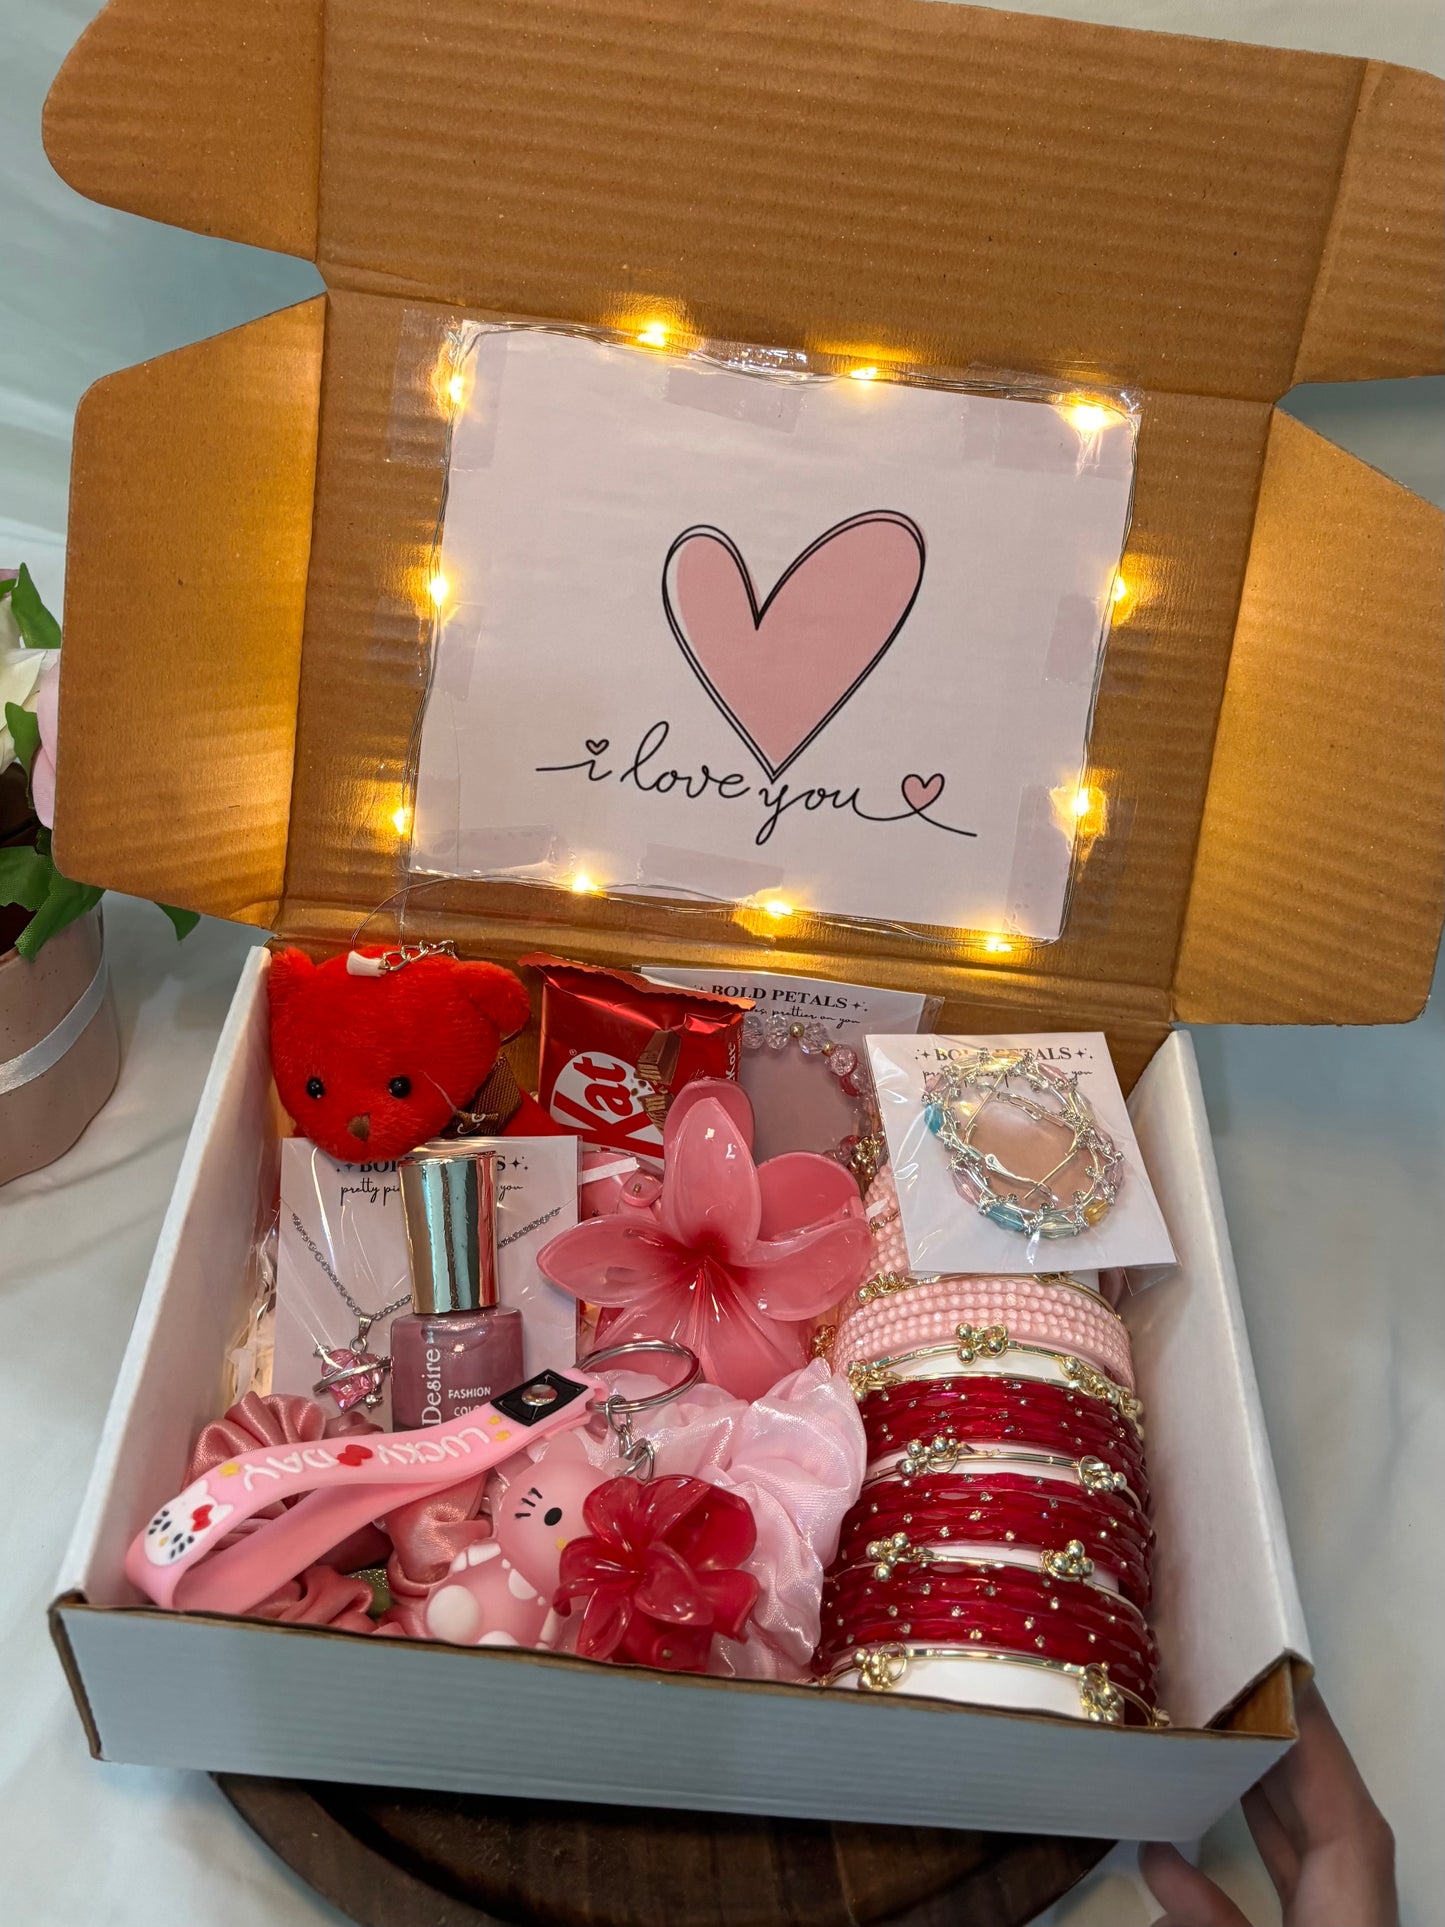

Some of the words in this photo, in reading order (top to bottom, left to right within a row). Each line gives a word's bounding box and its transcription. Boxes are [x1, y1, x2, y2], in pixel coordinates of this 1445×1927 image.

[620, 721, 750, 799] love
[755, 782, 896, 846] you
[712, 985, 767, 1000] BOLD
[771, 989, 848, 1010] PETALS
[340, 1177, 380, 1207] pretty
[421, 1348, 442, 1426] Desire
[448, 1386, 491, 1400] FASHION
[377, 1427, 490, 1465] LUCKY
[243, 1448, 339, 1491] DAY
